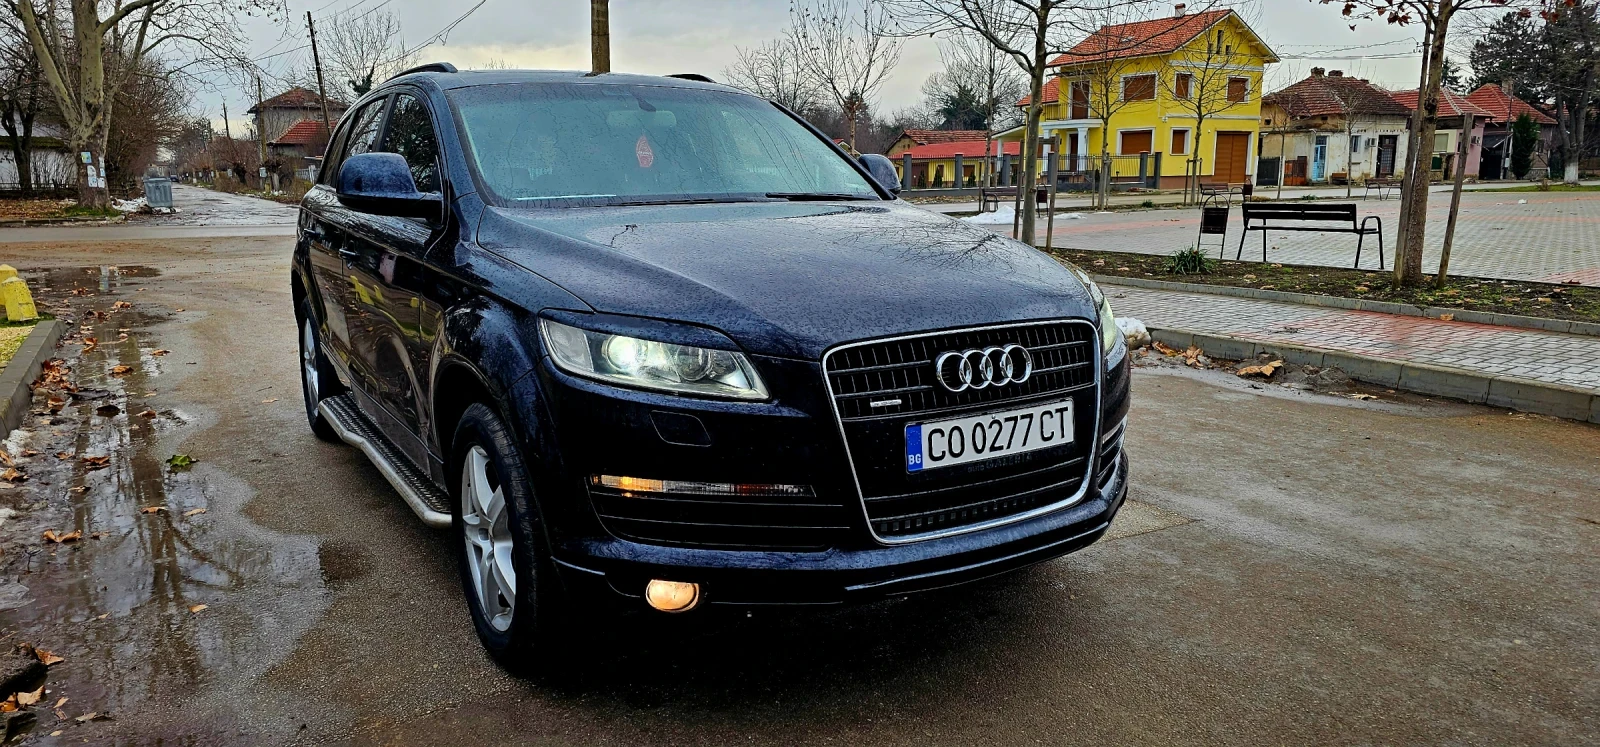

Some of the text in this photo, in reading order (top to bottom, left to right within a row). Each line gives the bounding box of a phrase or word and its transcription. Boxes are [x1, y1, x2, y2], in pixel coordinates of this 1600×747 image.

[928, 425, 966, 462] CO
[971, 413, 1034, 455] 0277
[1040, 406, 1069, 442] CT
[908, 453, 922, 465] BG
